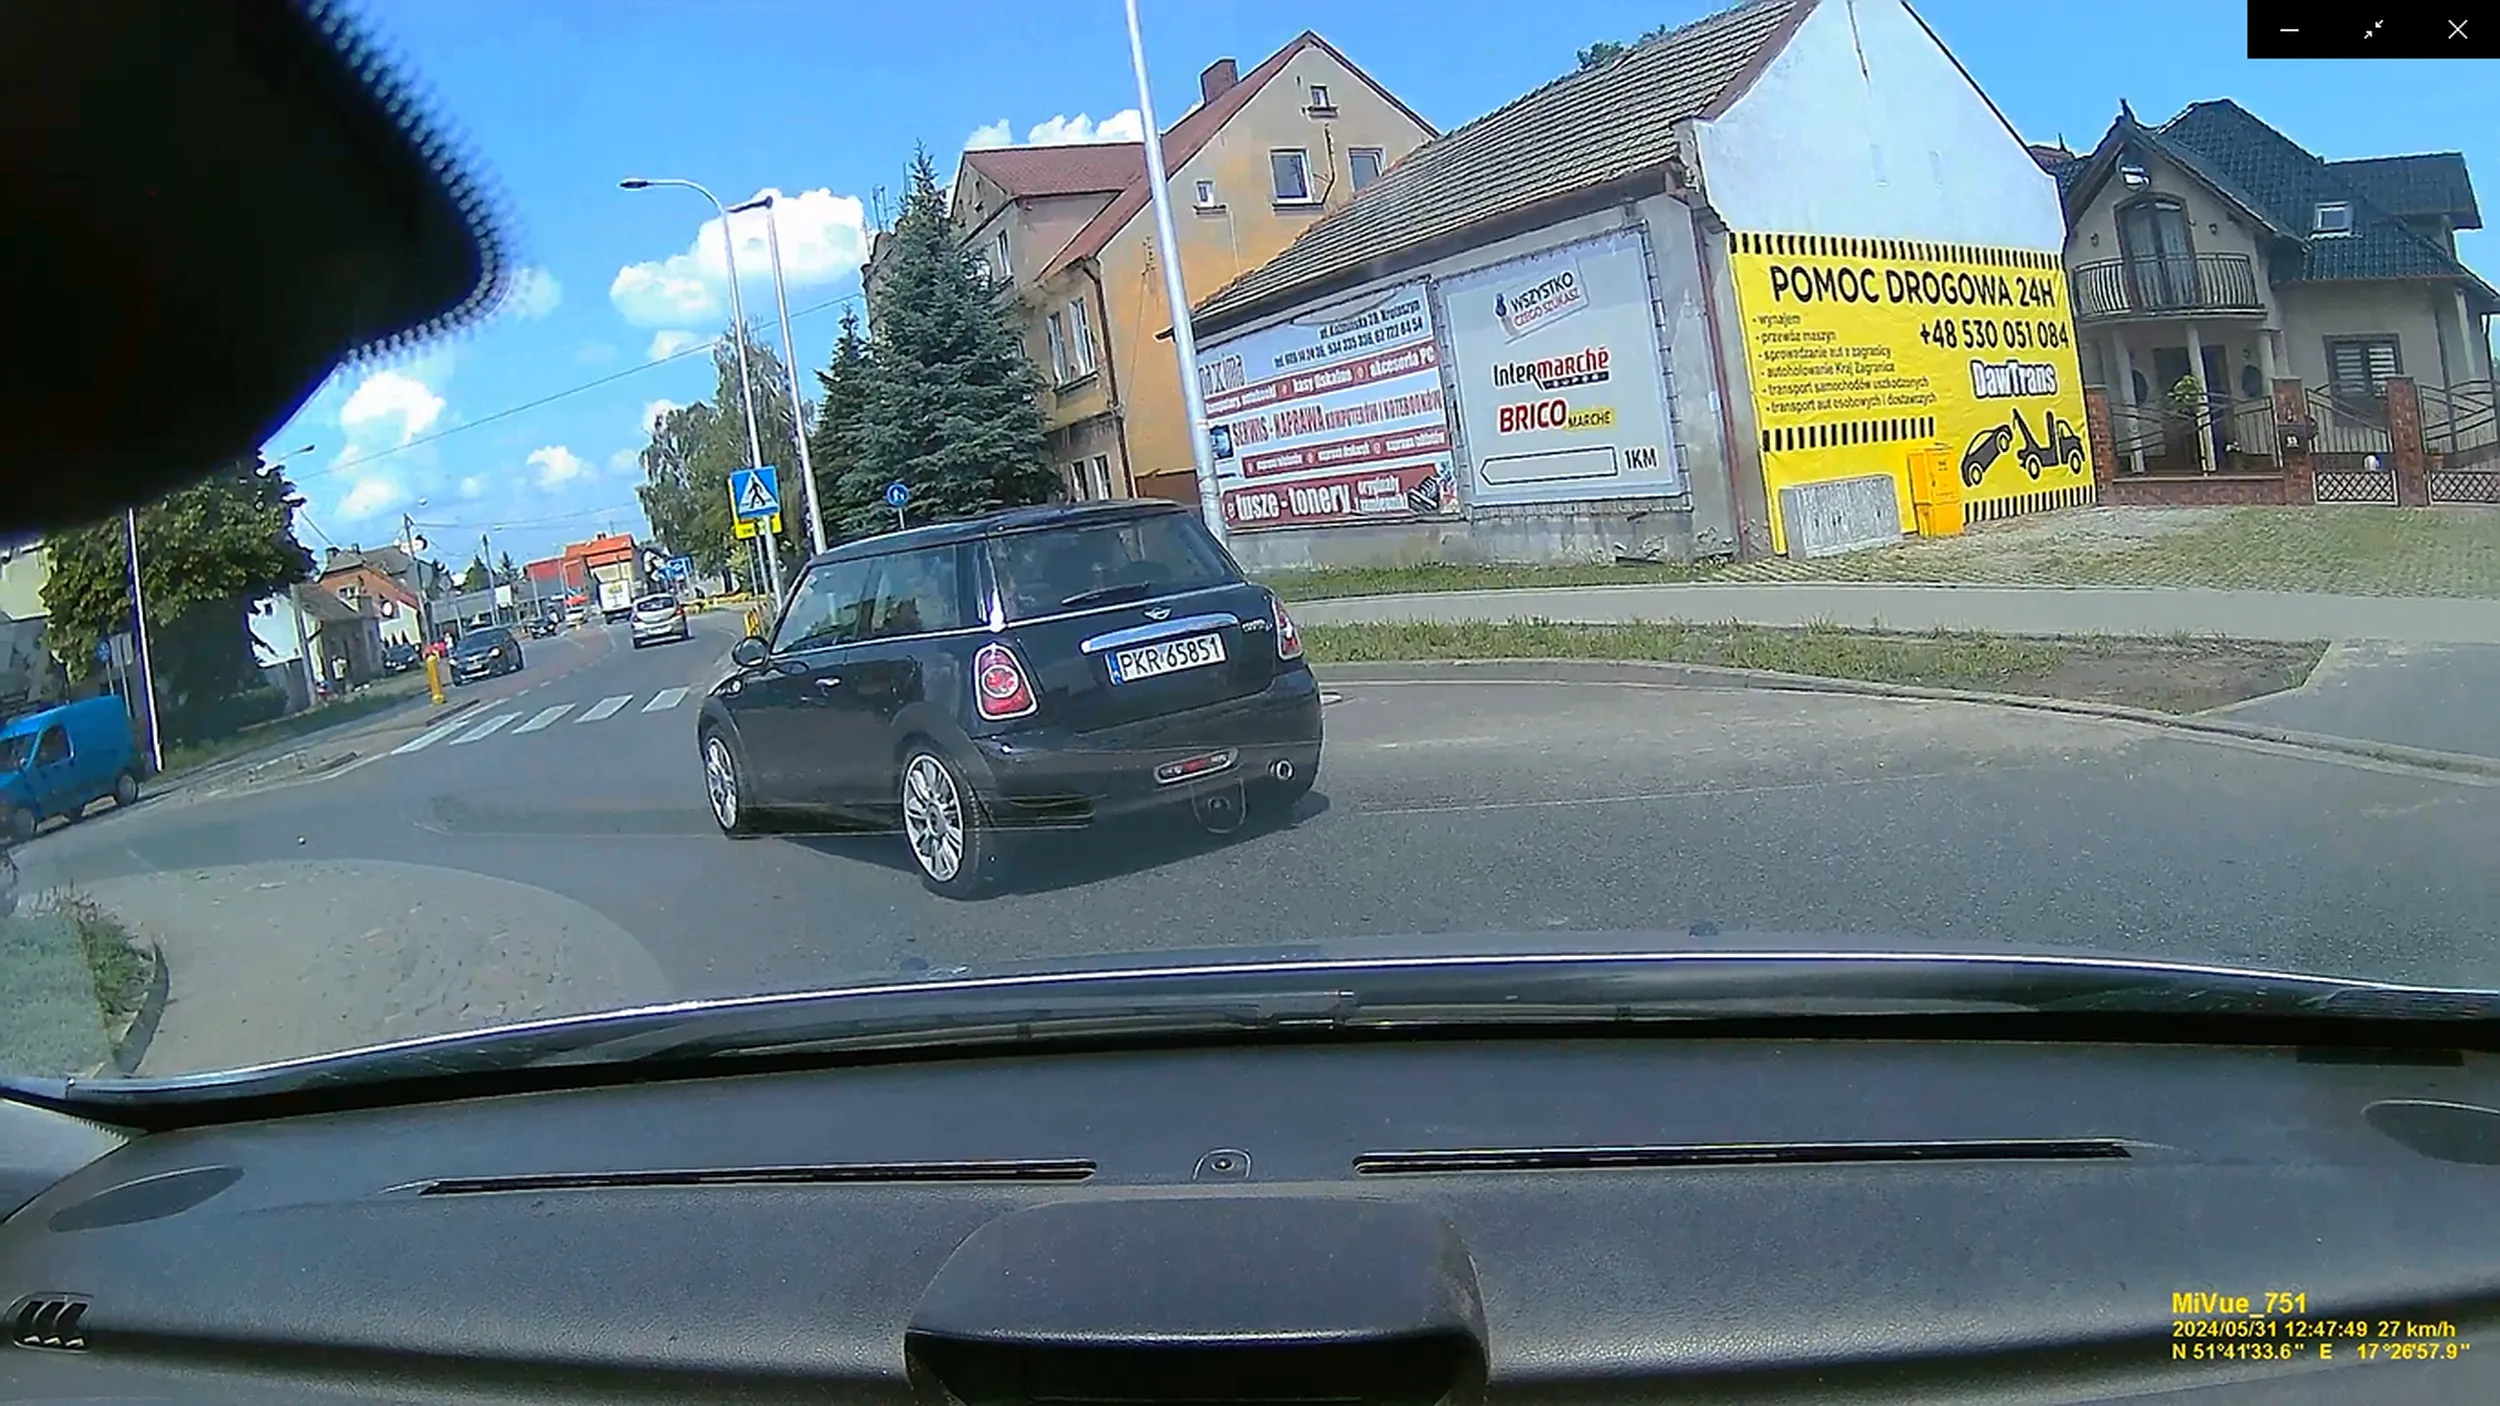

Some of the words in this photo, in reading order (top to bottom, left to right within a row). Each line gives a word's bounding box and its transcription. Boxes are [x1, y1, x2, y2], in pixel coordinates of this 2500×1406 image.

[1510, 271, 1574, 314] WSZYSTKO
[1769, 265, 1880, 304] POMOC
[1885, 268, 2014, 307] DROGOWA
[2015, 276, 2056, 308] 24H
[1514, 305, 1543, 327] CZEGO
[1543, 286, 1580, 314] SZUKASZ
[1757, 312, 1801, 328] wynajem
[1761, 329, 1801, 345] przewóz
[1802, 330, 1837, 344] maszyn
[1919, 318, 1958, 349] +48
[1961, 319, 1998, 349] 530
[2002, 320, 2035, 349] 051
[2037, 320, 2070, 349] 084
[1368, 349, 1420, 377] akcesoria
[1419, 345, 1436, 366] PC
[1493, 346, 1610, 391] Intermarché
[1764, 346, 1828, 362] sprowadzanie
[1851, 344, 1892, 360] zagranicy
[1767, 361, 1834, 378] autoholowanie
[1767, 382, 1814, 397] transport
[1814, 376, 1871, 393] samochodów
[1873, 375, 1930, 391] uszkodzonych
[1971, 360, 2059, 400] DawTrans
[1499, 399, 1567, 433] BRICO
[1771, 398, 1817, 414] transport
[1817, 398, 1832, 410] aut
[1832, 393, 1882, 410] osobowych
[1887, 391, 1938, 407] dostawczych
[1231, 415, 1270, 448] SERWIS
[1273, 404, 1326, 440] NAPRAWA
[1625, 447, 1658, 470] 1KM
[1237, 490, 1280, 521] tusze
[1288, 483, 1351, 517] tonery
[1119, 647, 1161, 678] PKR
[1165, 636, 1222, 669] 65851
